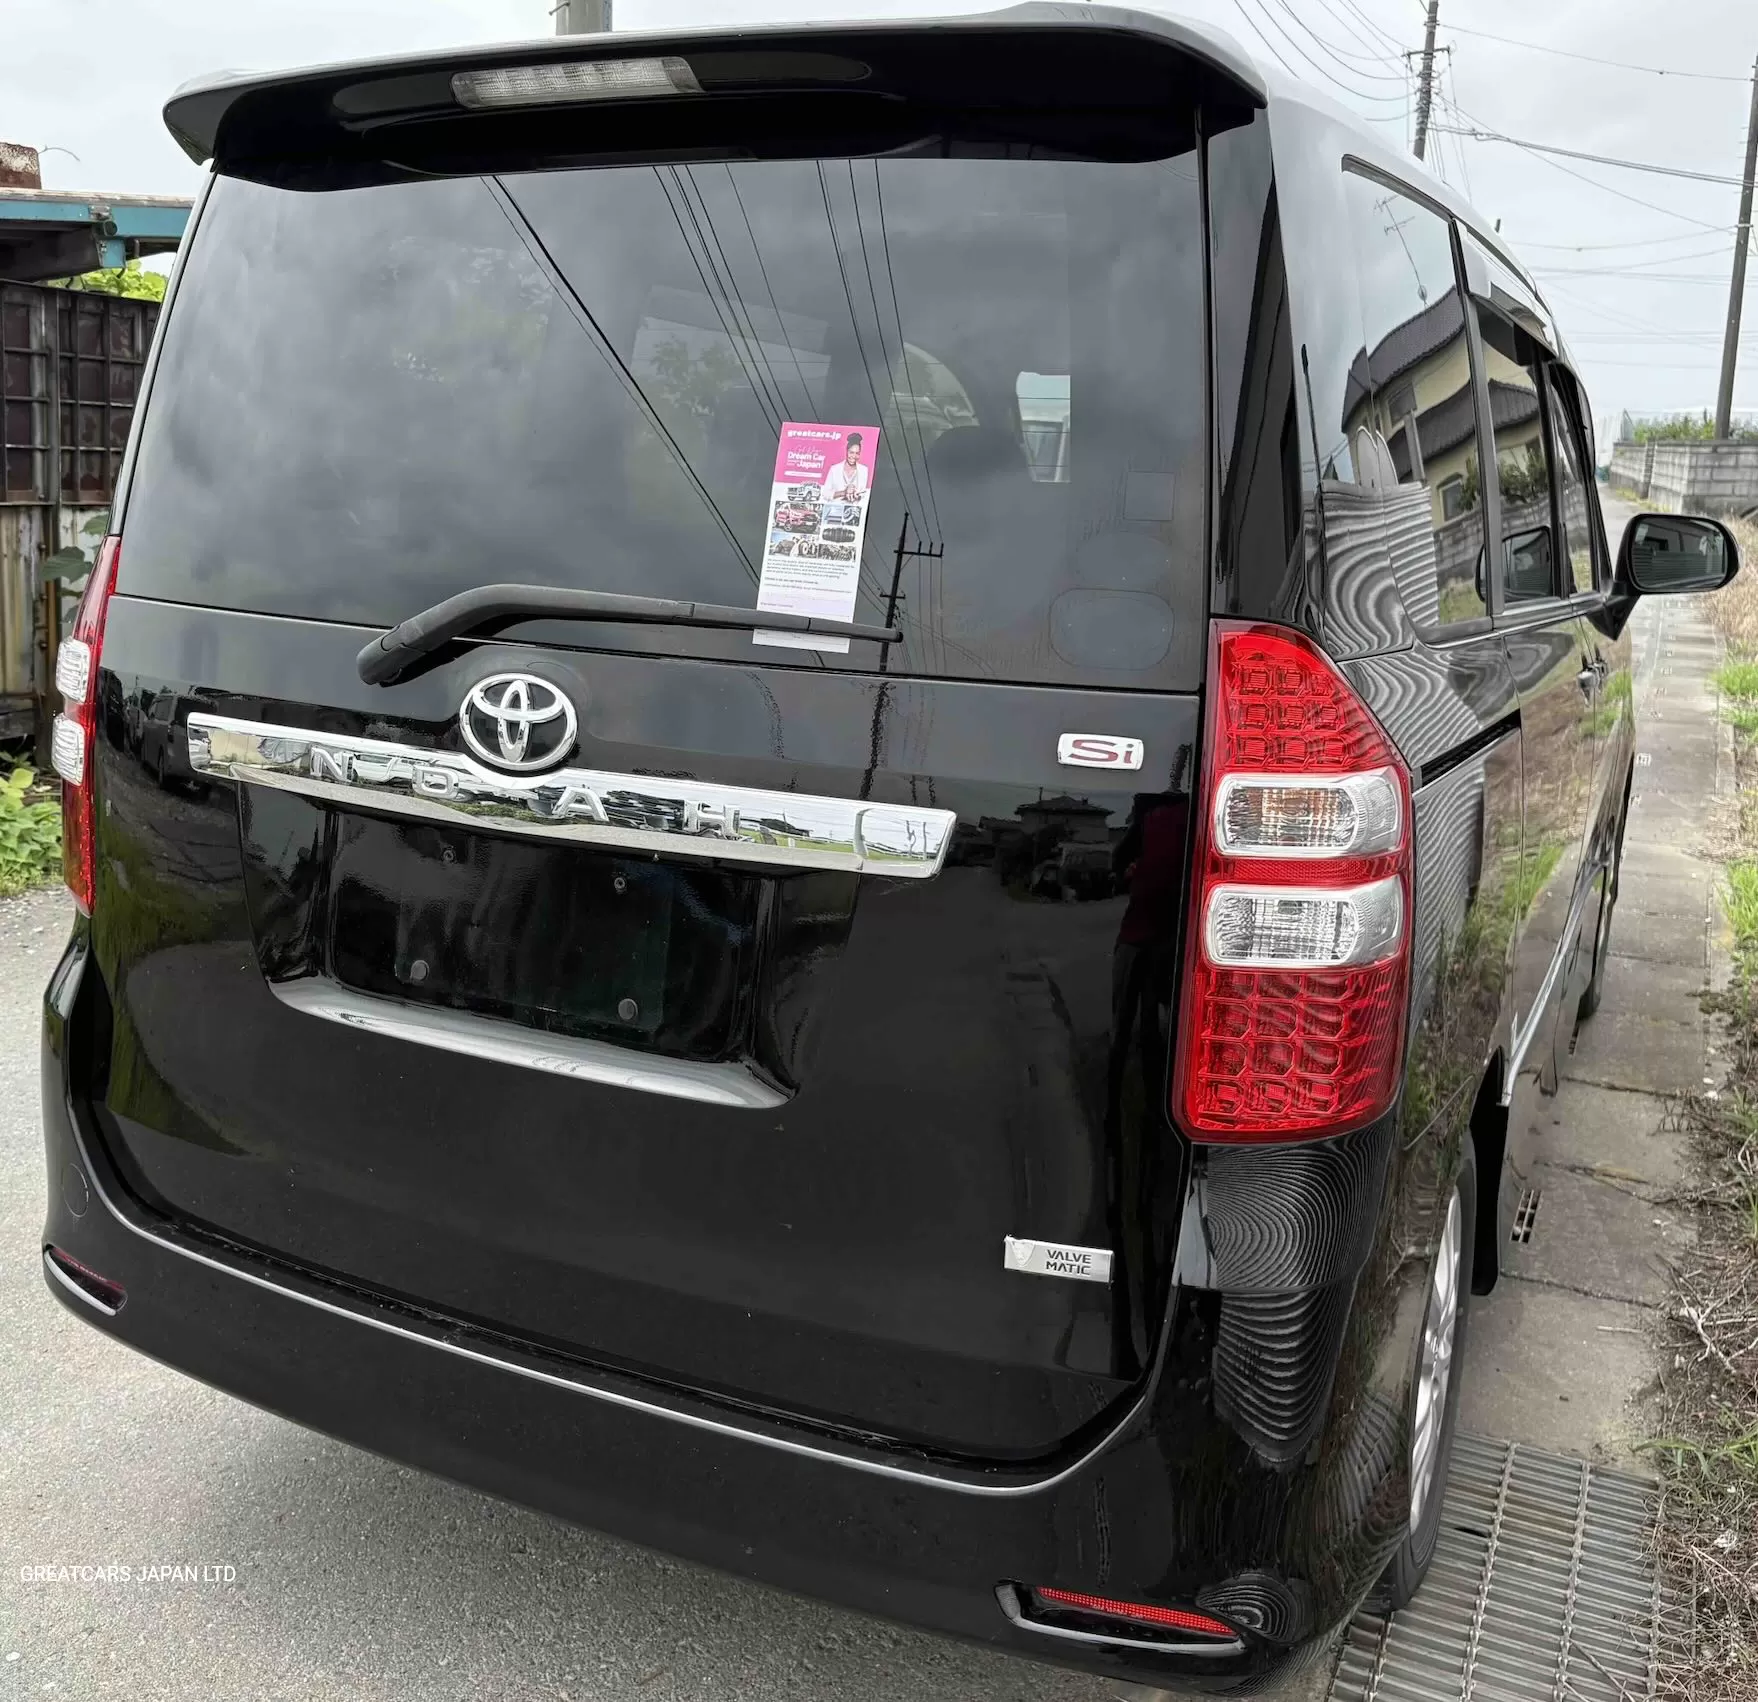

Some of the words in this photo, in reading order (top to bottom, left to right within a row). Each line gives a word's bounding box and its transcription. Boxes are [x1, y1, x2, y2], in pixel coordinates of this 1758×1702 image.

[787, 430, 842, 440] greatcars.jp
[788, 451, 812, 460] Dream
[812, 453, 826, 461] Car
[796, 460, 824, 469] Japan!
[1068, 739, 1134, 764] Si
[1047, 1249, 1092, 1264] VALVE
[1045, 1260, 1091, 1276] MATIC
